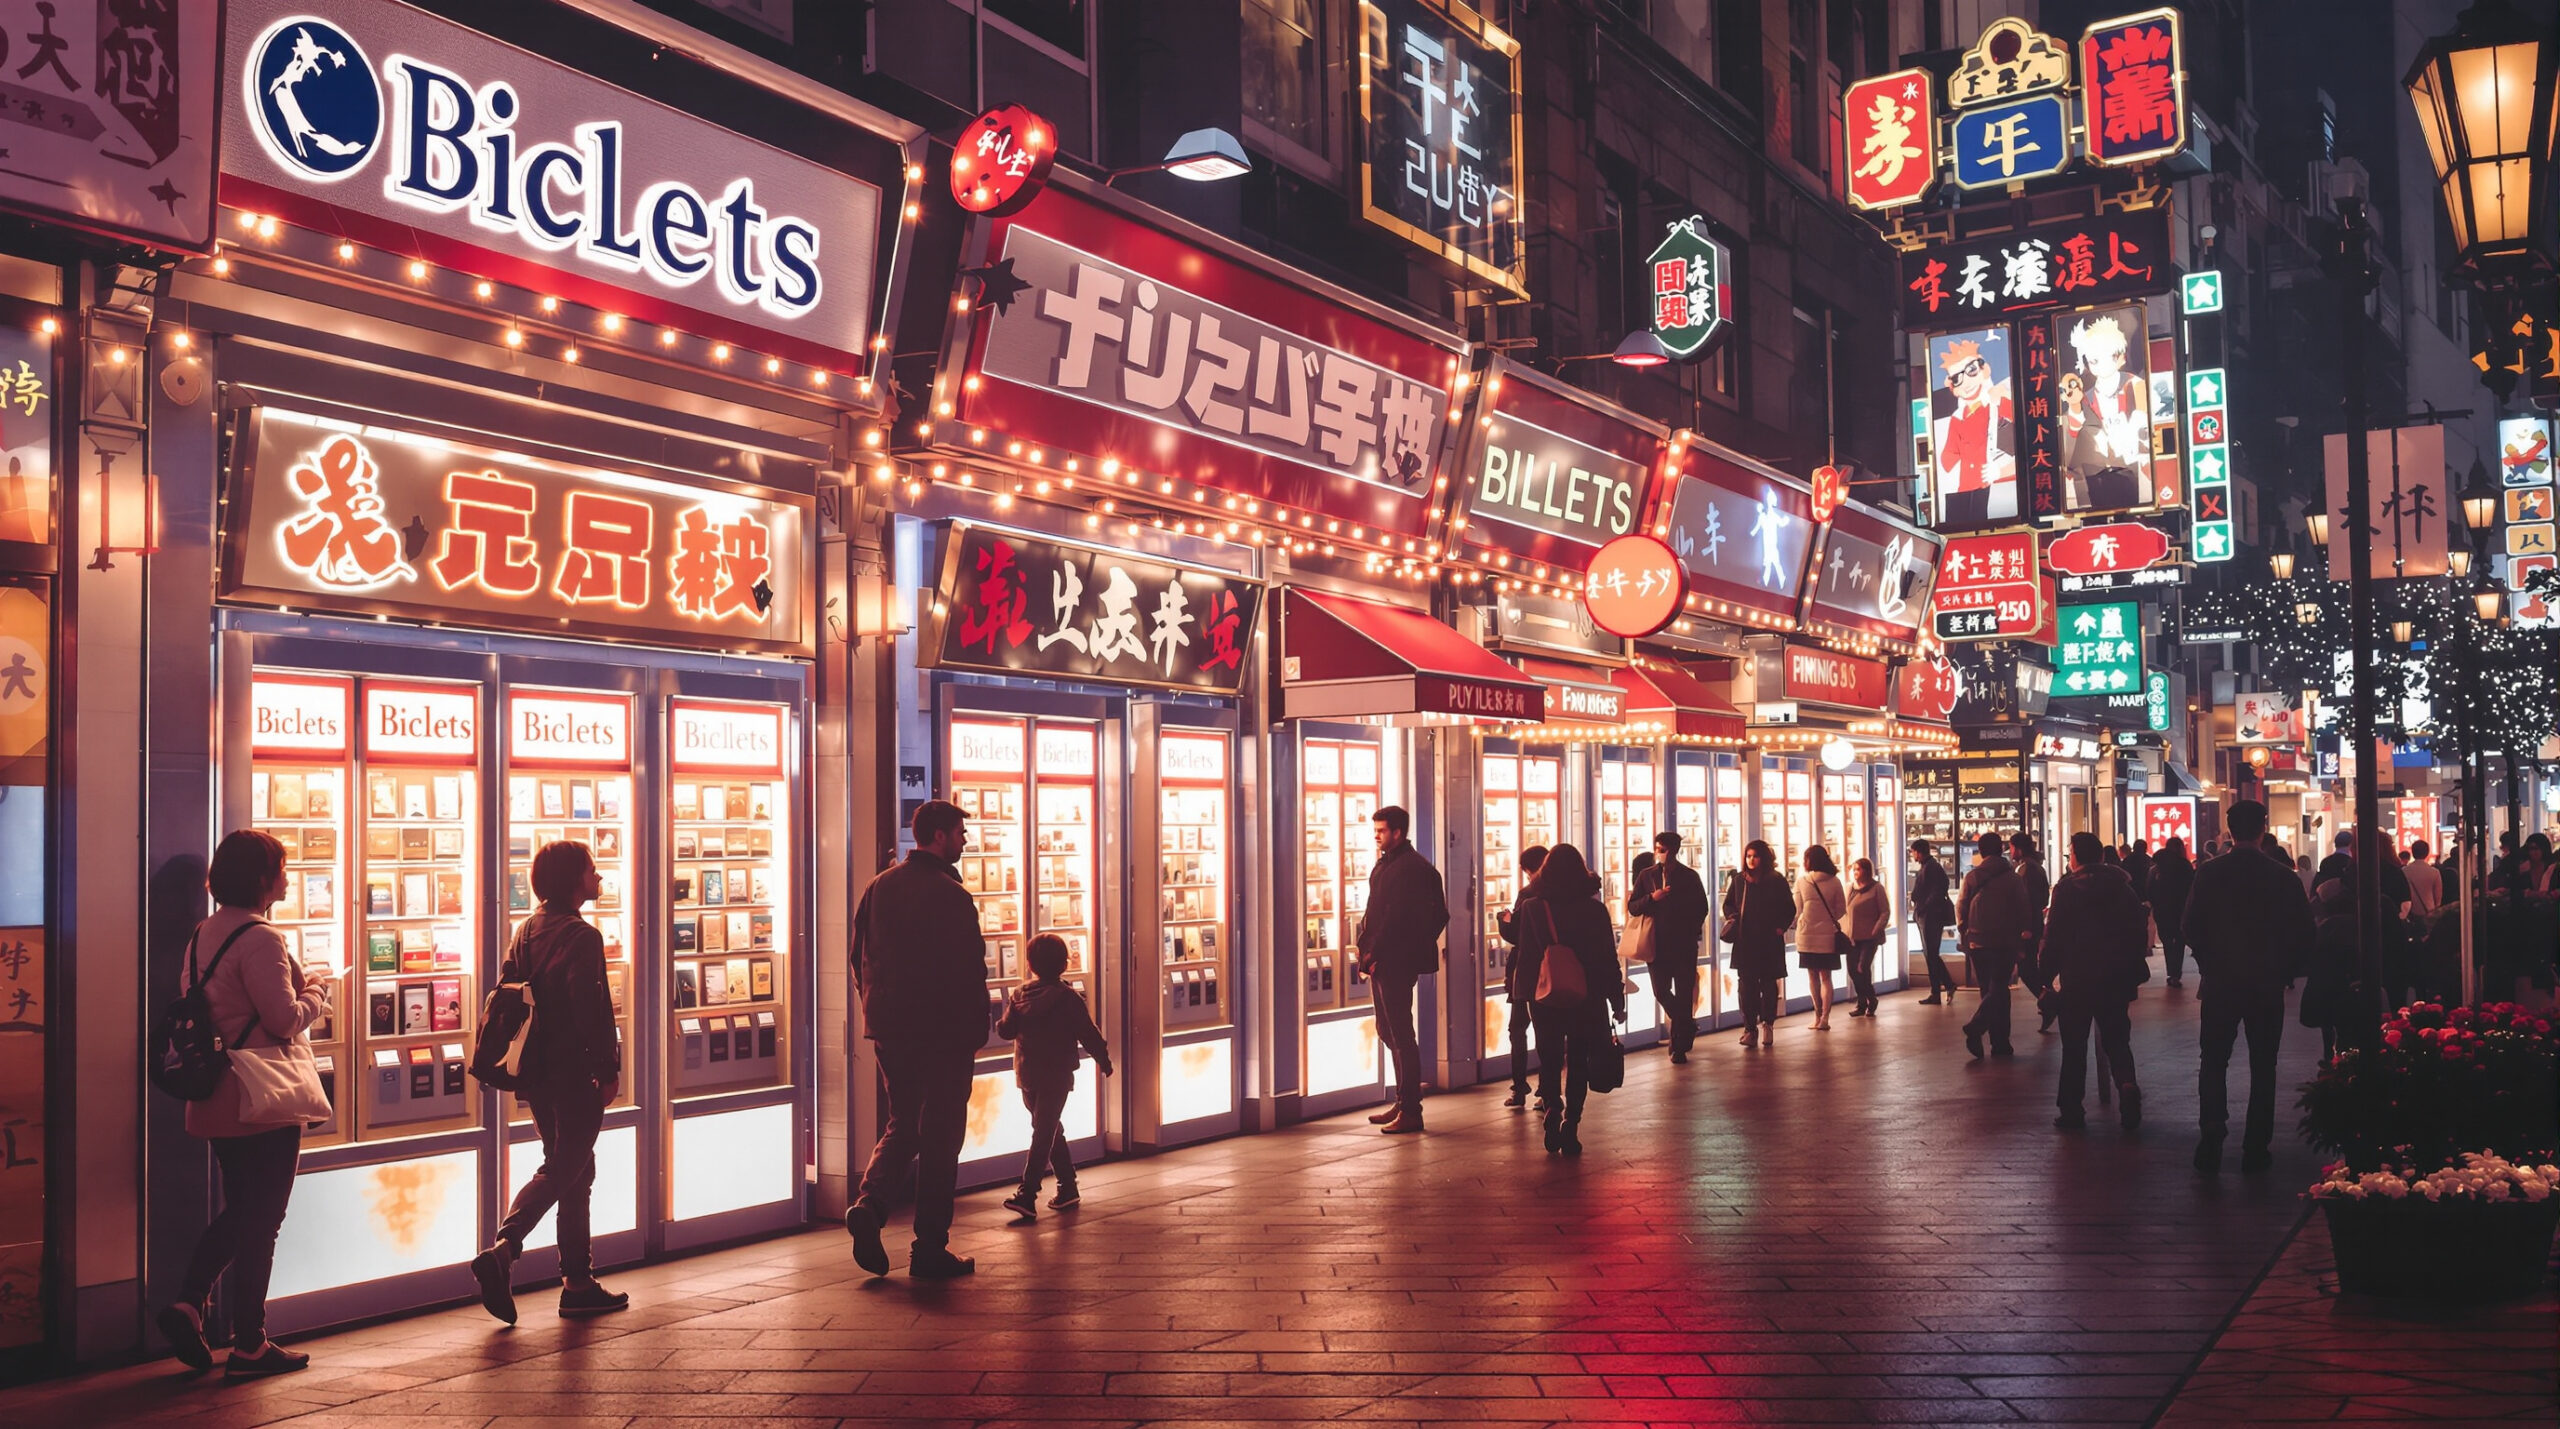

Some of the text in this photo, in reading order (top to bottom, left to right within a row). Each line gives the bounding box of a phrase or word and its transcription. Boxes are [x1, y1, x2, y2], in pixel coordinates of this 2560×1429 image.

[1480, 445, 1632, 535] BILLETS
[1998, 600, 2031, 621] 250
[256, 705, 337, 736] Biclets
[379, 703, 472, 740] Biclets
[523, 711, 614, 745] Biclets
[962, 735, 1020, 761] Biclets
[1167, 748, 1213, 770] Biclets
